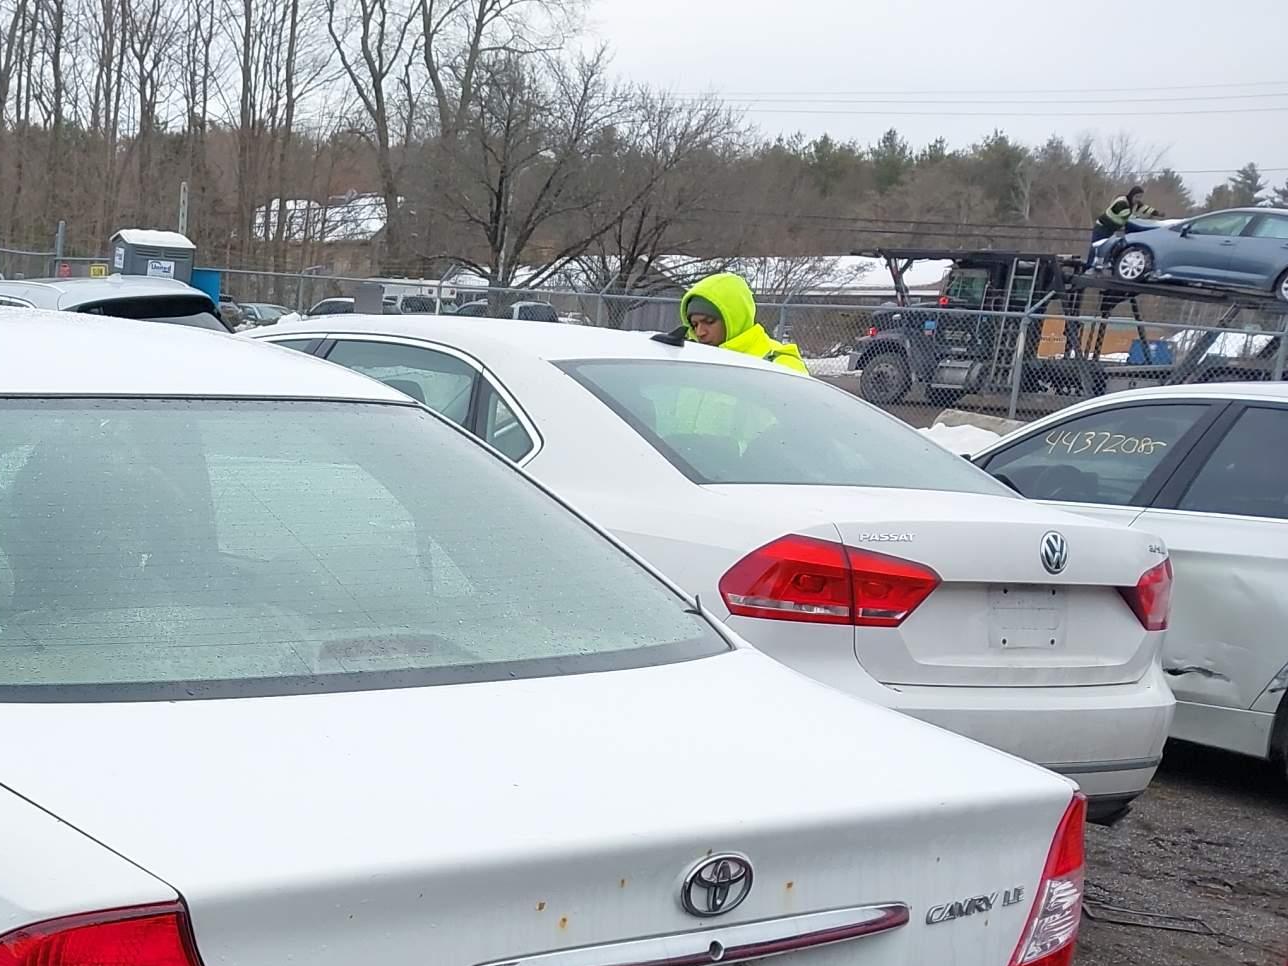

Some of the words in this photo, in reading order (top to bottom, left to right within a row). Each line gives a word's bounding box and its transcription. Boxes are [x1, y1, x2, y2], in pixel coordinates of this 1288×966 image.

[859, 532, 915, 542] PASSAT
[926, 892, 999, 924] CAMRY
[1002, 886, 1024, 907] LE
